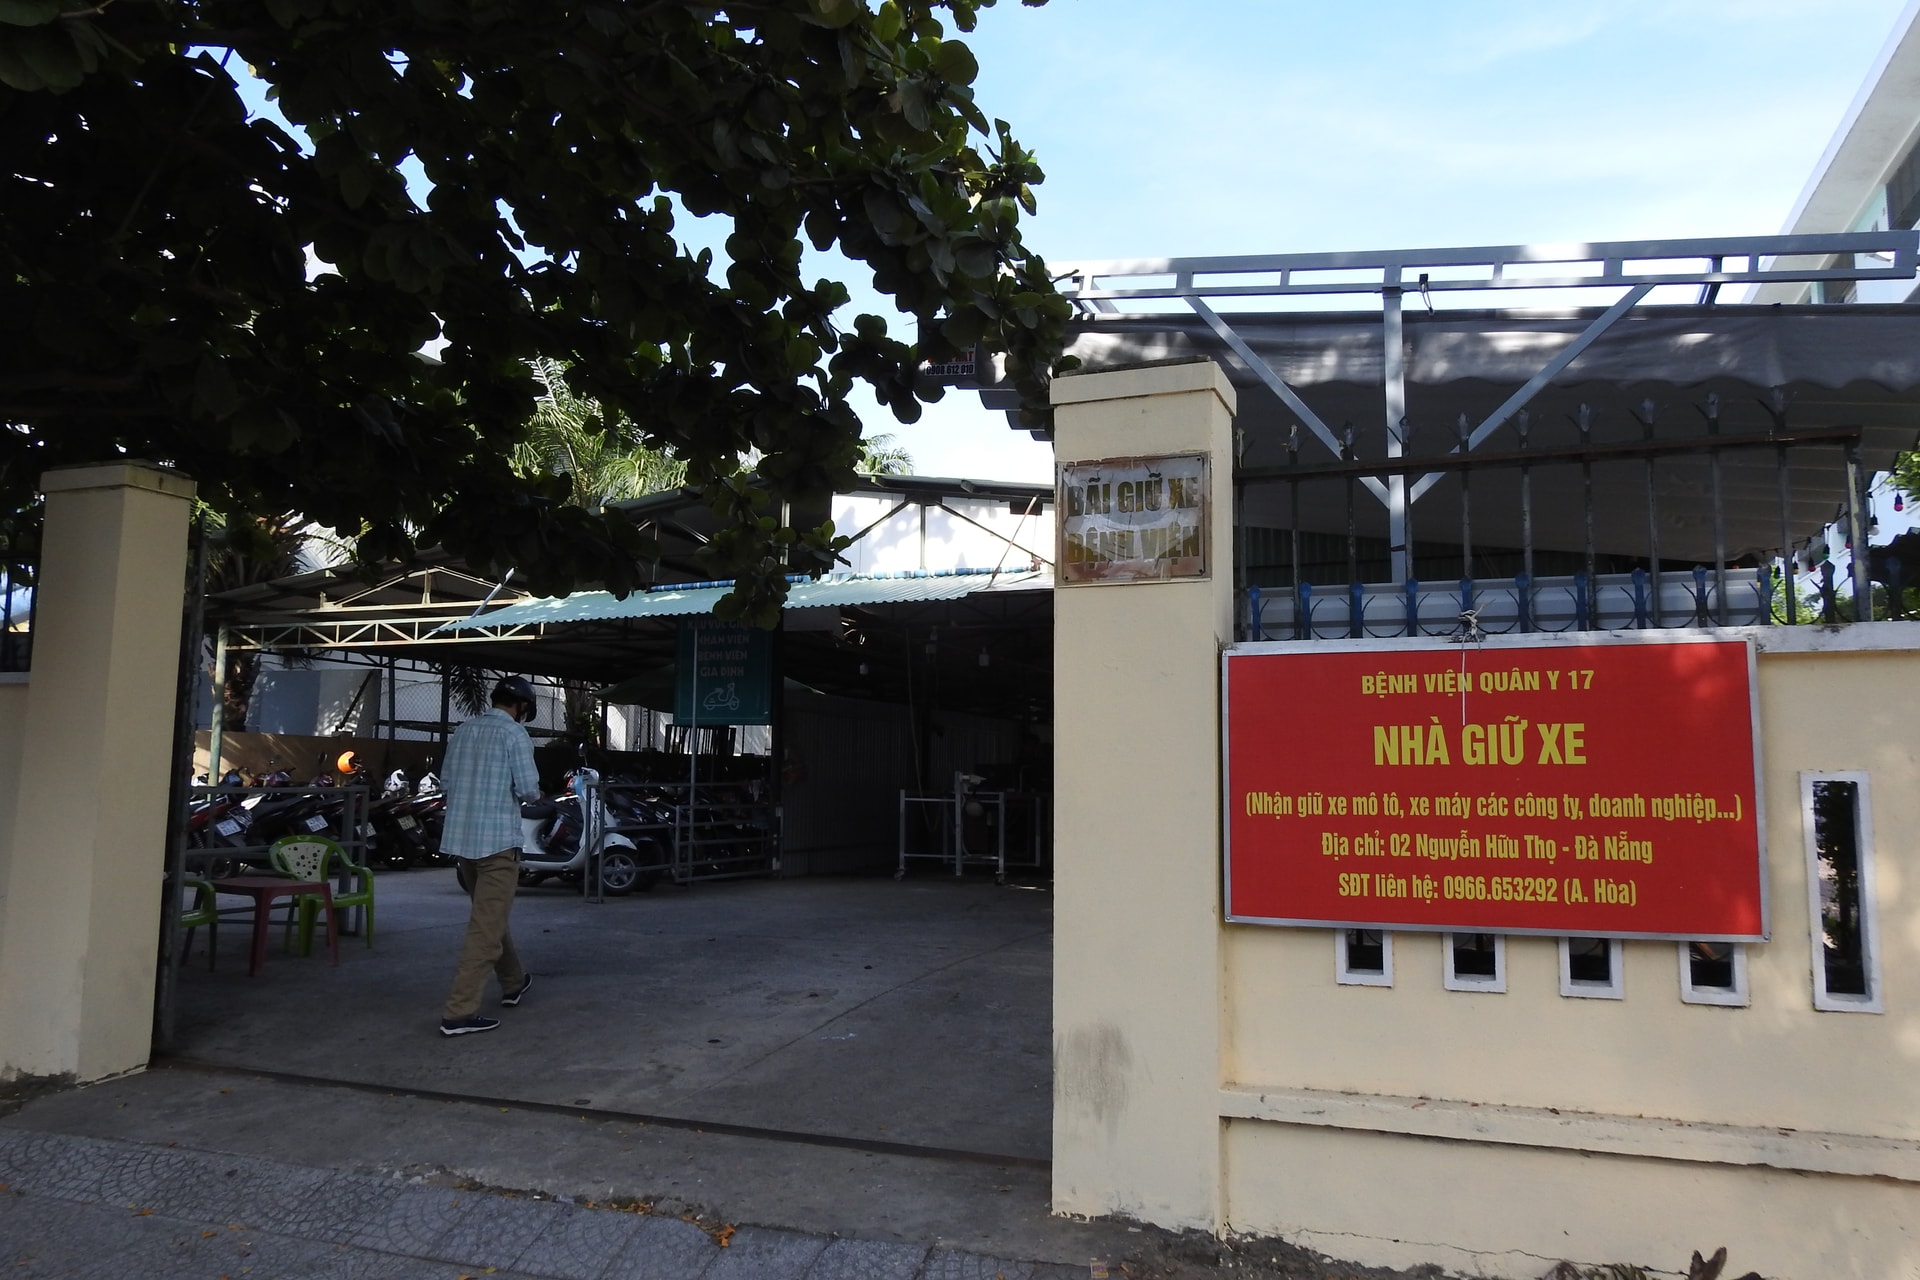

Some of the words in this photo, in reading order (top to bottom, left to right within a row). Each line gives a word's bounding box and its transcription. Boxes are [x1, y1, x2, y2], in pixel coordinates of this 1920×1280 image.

[1068, 477, 1111, 517] BÃI
[1117, 472, 1163, 514] GIỮ
[1168, 477, 1199, 510] XE
[1361, 671, 1417, 698] BỆNH
[1423, 668, 1473, 697] VIỆN
[1479, 667, 1540, 694] QUÂN
[1546, 670, 1560, 690] Y
[1567, 670, 1594, 690] 17
[1373, 716, 1450, 766] NHÀ
[1461, 715, 1528, 766] GIỮ
[1536, 722, 1587, 765] XE
[1246, 791, 1293, 820] (Nhận
[1297, 792, 1323, 818] giữ
[1328, 796, 1347, 816] xe
[1352, 792, 1378, 816] mô
[1383, 792, 1405, 819] tô,
[1409, 796, 1430, 817] xe
[1435, 792, 1472, 819] máy
[1476, 792, 1509, 817] các
[1514, 792, 1558, 820] công
[1563, 793, 1584, 821] ty,
[1589, 793, 1646, 818] doanh
[1651, 792, 1743, 824] nghiệp...)
[1321, 832, 1349, 861] Địa
[1354, 829, 1385, 856] chỉ:
[1390, 833, 1411, 857] 02
[1415, 829, 1481, 861] Nguyễn
[1486, 834, 1519, 859] Hữu
[1524, 834, 1557, 864] Thọ
[1575, 834, 1599, 860] Đà
[1604, 830, 1653, 864] Nẵng
[1338, 872, 1370, 897] SĐT
[1375, 873, 1407, 898] liên
[1412, 874, 1439, 904] hệ:
[1443, 875, 1558, 902] 0966.653292
[1563, 878, 1589, 905] (A.
[1594, 878, 1637, 907] Hòa)
